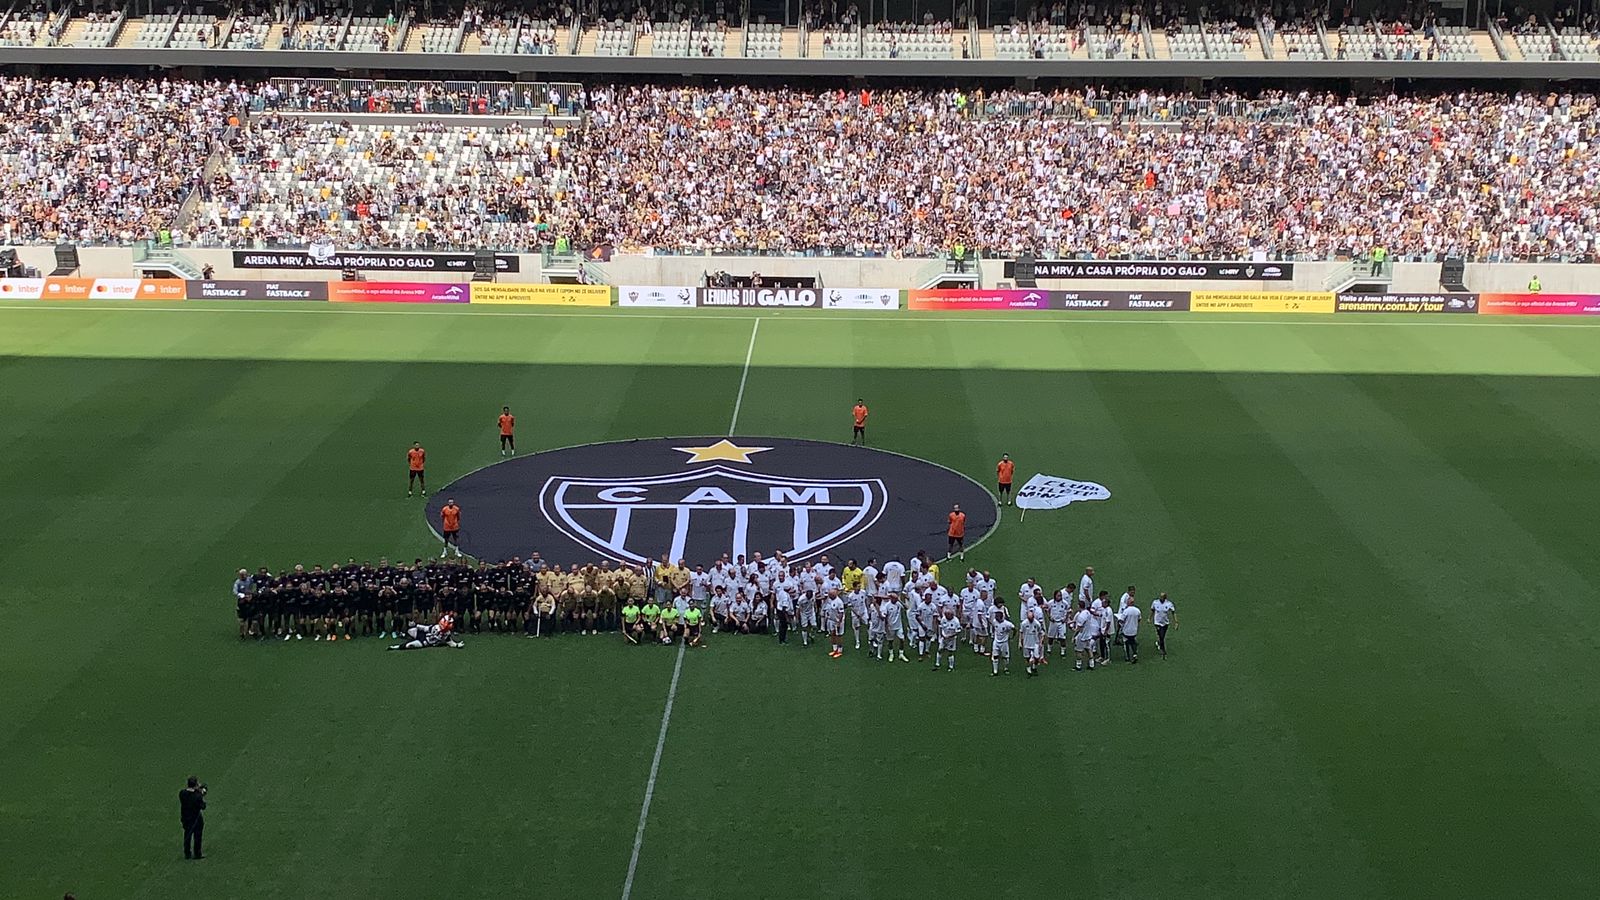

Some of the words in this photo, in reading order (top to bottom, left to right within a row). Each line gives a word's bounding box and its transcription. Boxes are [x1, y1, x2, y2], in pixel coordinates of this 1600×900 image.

[244, 255, 278, 265] ARENA
[280, 256, 304, 267] MRV,
[305, 257, 313, 265] A
[343, 255, 388, 267] PRÓPRIA
[389, 258, 404, 267] DO
[406, 258, 435, 267] GALO
[1051, 266, 1074, 276] MRV,
[1076, 266, 1084, 275] A
[1086, 266, 1112, 275] CASA
[1114, 264, 1158, 275] PRÓPRIA
[1160, 266, 1176, 275] DO
[1178, 266, 1207, 276] GALO
[18, 285, 39, 293] inter
[65, 285, 86, 293] inter
[113, 285, 133, 293] inter
[160, 285, 182, 293] inter
[703, 289, 739, 305] LENDAS
[742, 289, 755, 305] DO
[757, 289, 816, 306] GALO
[1339, 302, 1444, 312] arenamrv.com.br/tour
